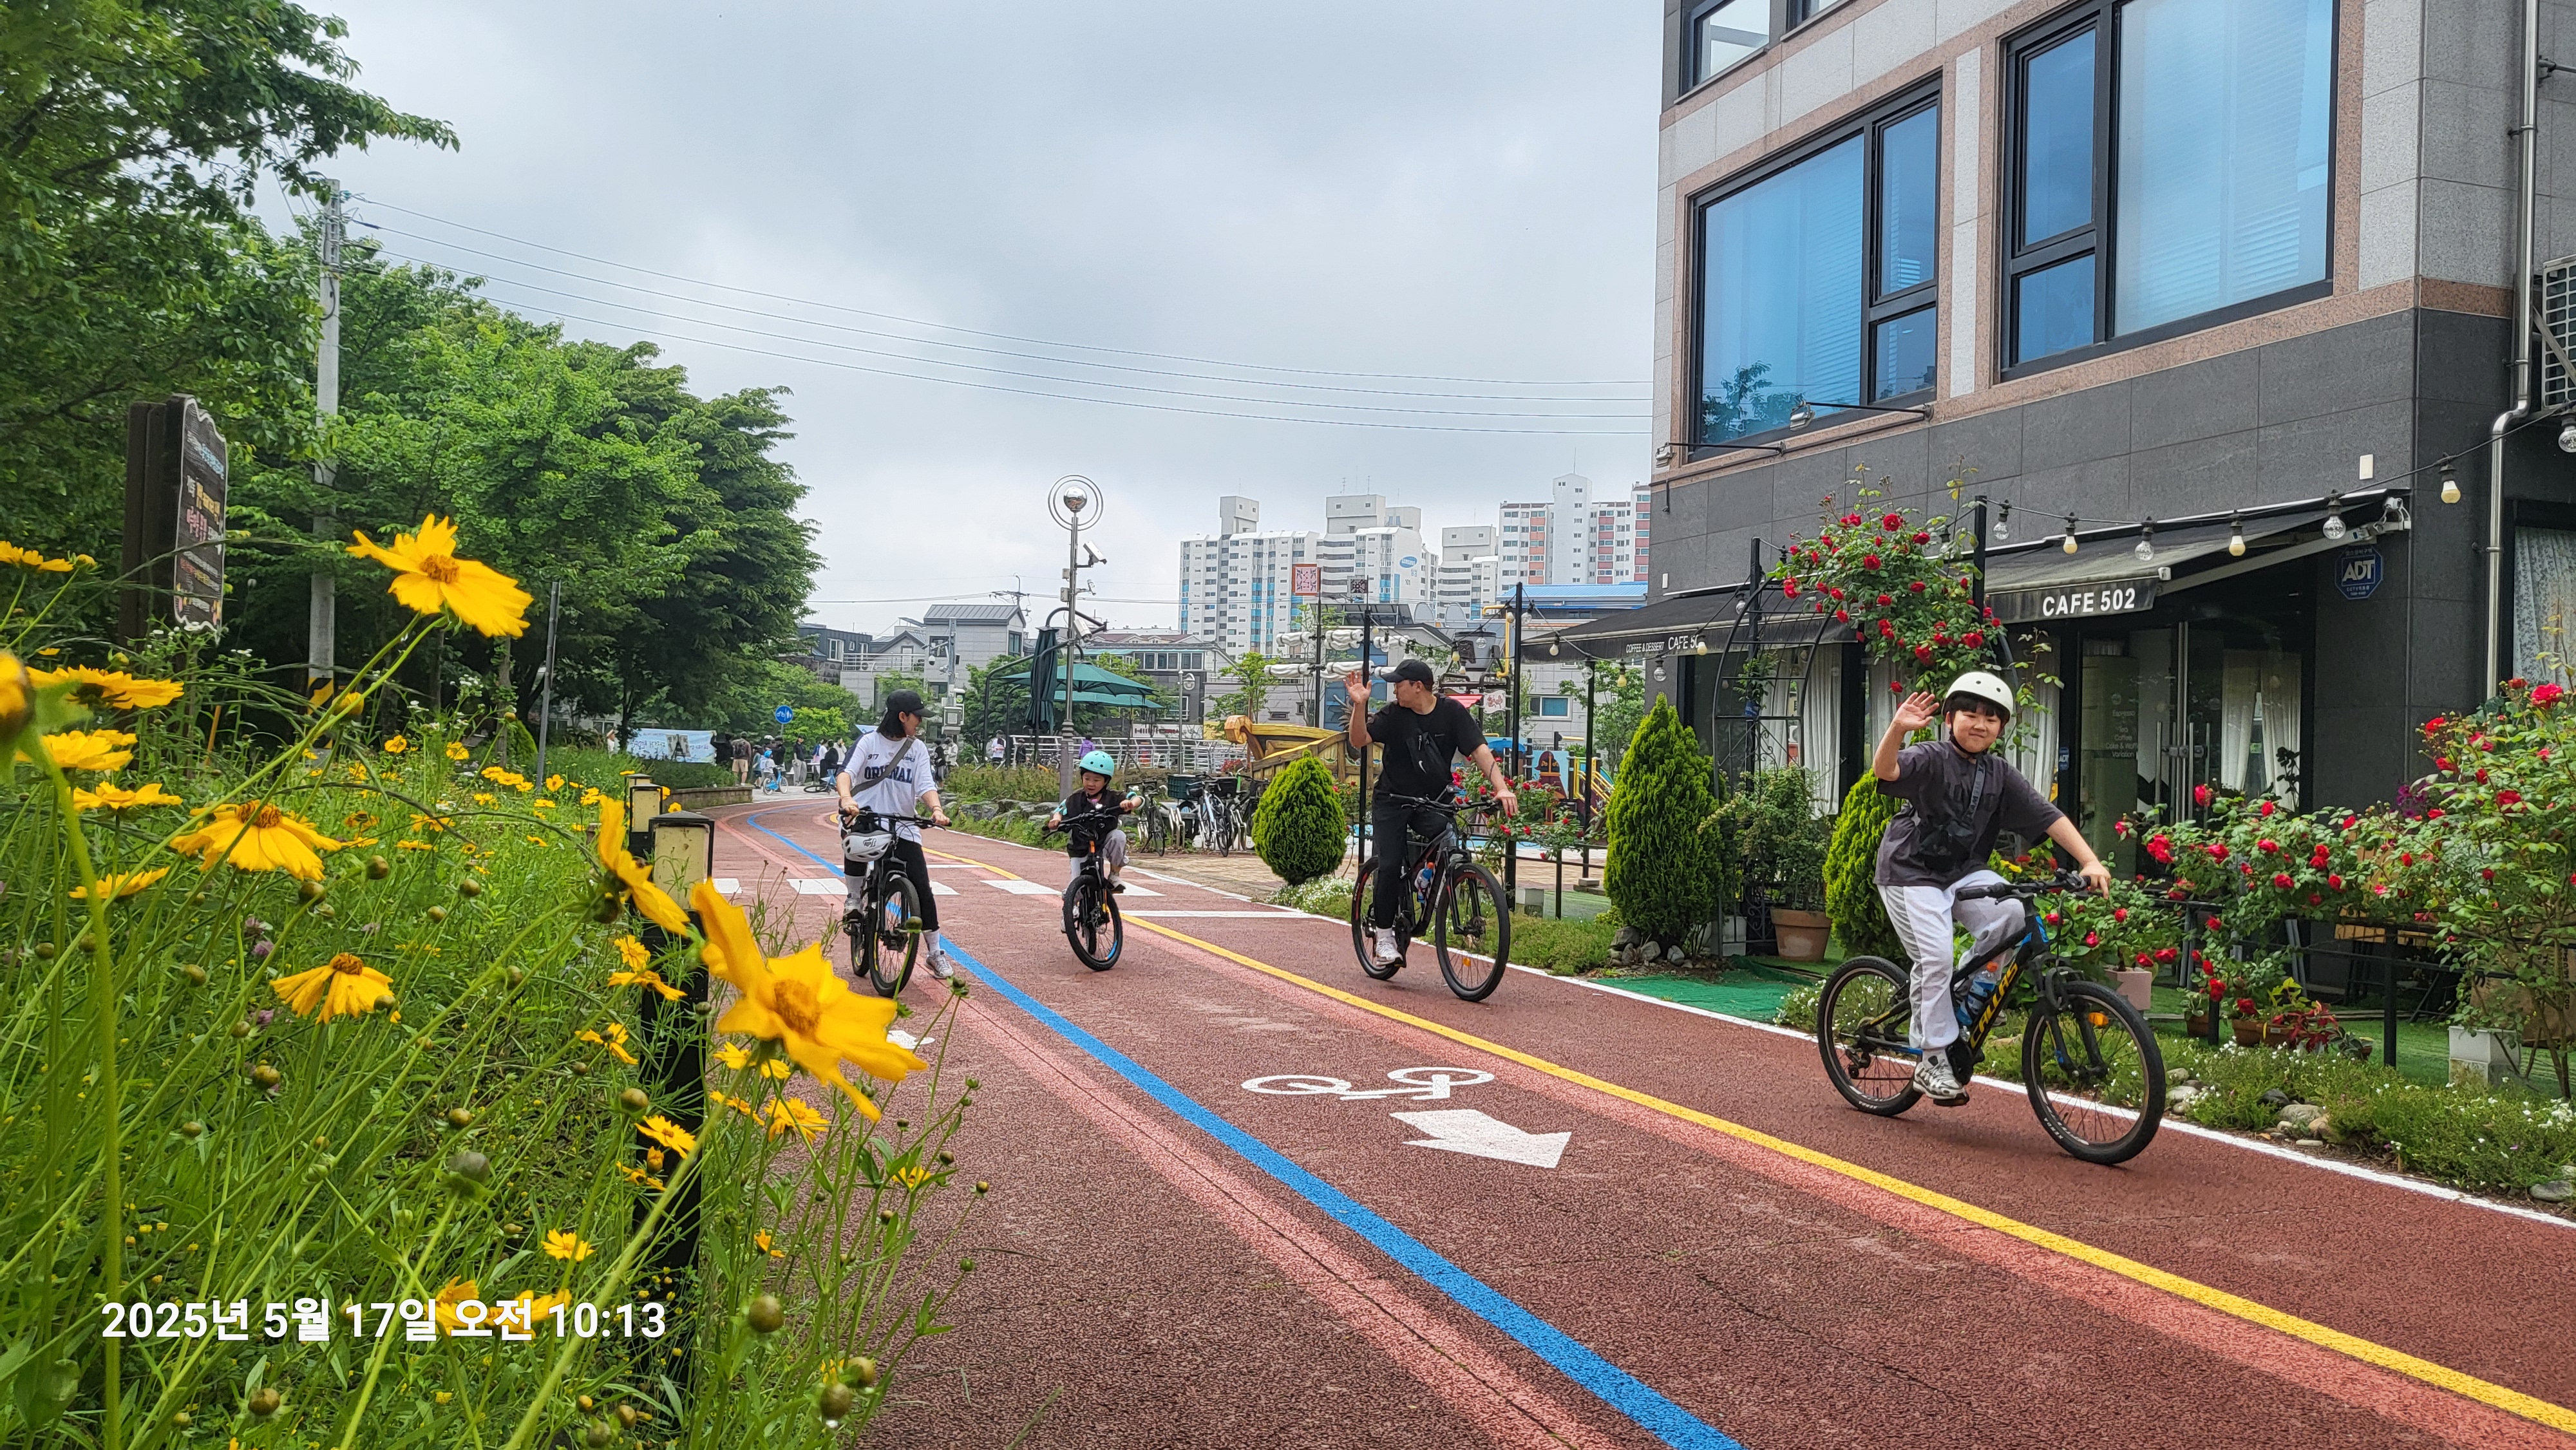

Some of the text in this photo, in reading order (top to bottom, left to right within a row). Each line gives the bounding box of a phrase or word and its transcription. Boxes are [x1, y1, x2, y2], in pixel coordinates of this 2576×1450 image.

[2342, 560, 2375, 582] ADT
[2043, 588, 2136, 616] CAFE 502
[1626, 643, 1642, 654] COFFEE
[1645, 641, 1665, 652] DESSERT
[1668, 636, 1689, 650] CAFE
[1970, 960, 2019, 1050] CALLAS
